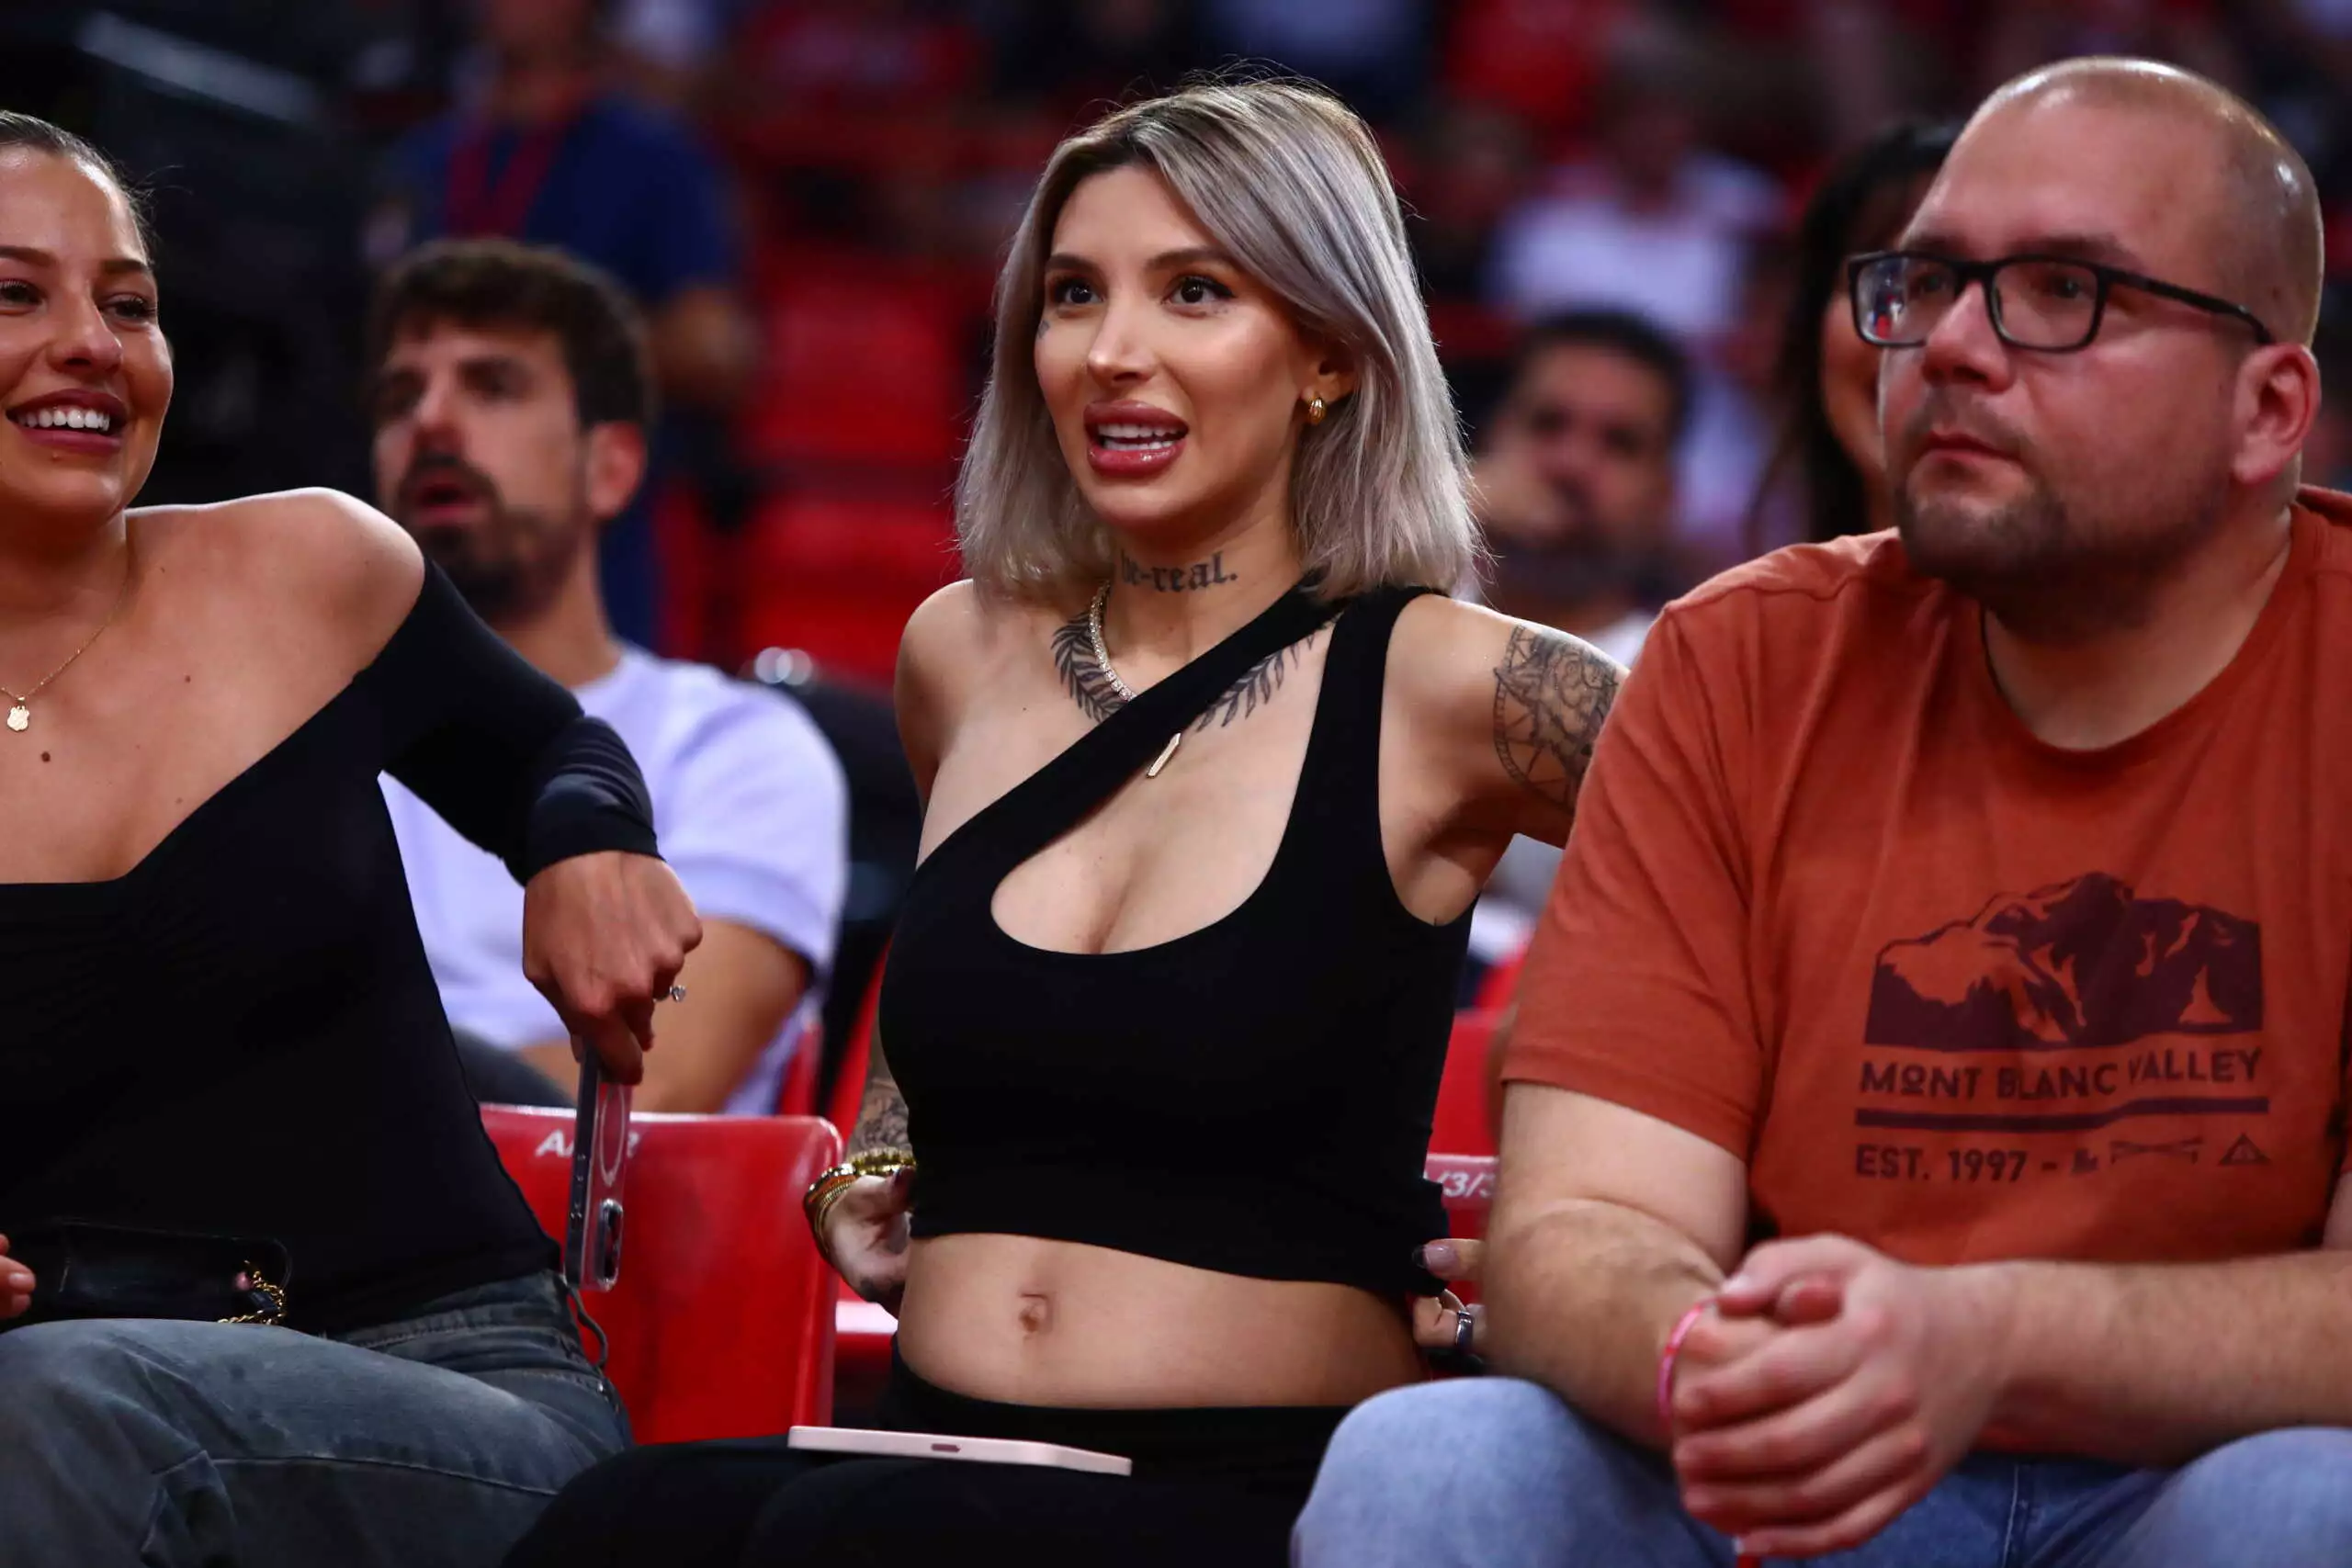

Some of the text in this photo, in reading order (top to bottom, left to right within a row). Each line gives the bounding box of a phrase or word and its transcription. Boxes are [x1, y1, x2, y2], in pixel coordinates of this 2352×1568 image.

[1860, 1046, 2263, 1101] MONT BLANC VALLEY
[1855, 1143, 1930, 1181] EST.
[1948, 1148, 2028, 1183] 1997
